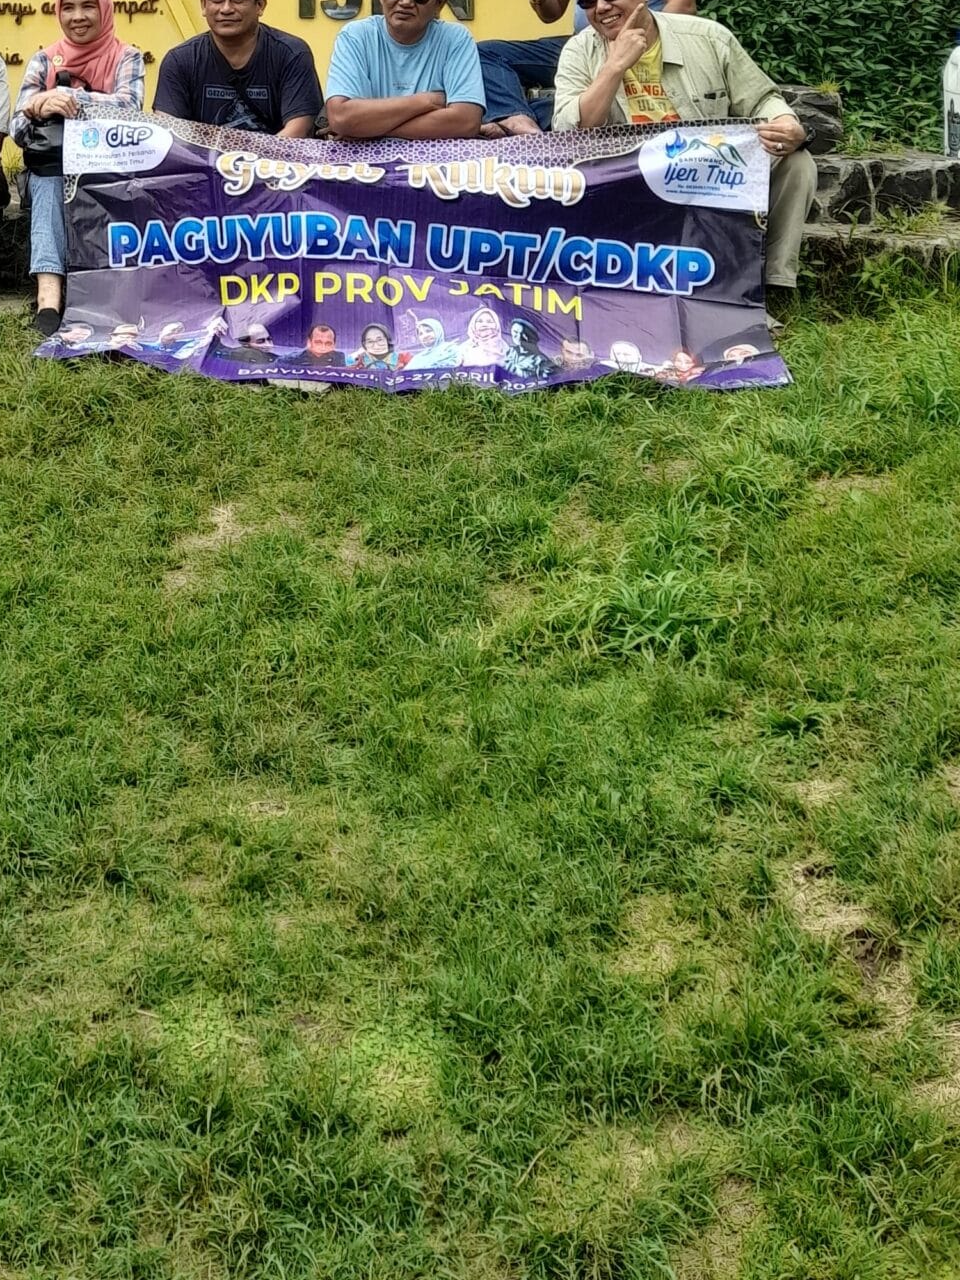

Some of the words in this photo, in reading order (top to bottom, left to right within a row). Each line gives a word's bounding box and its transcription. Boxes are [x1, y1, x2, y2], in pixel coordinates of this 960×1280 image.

[664, 162, 700, 185] Ijen
[707, 164, 747, 190] Trip
[108, 211, 415, 267] PAGUYUBAN
[426, 224, 716, 296] UPT/CDKP
[219, 272, 301, 307] DKP
[315, 273, 435, 307] PROV
[448, 278, 584, 321] JATIM
